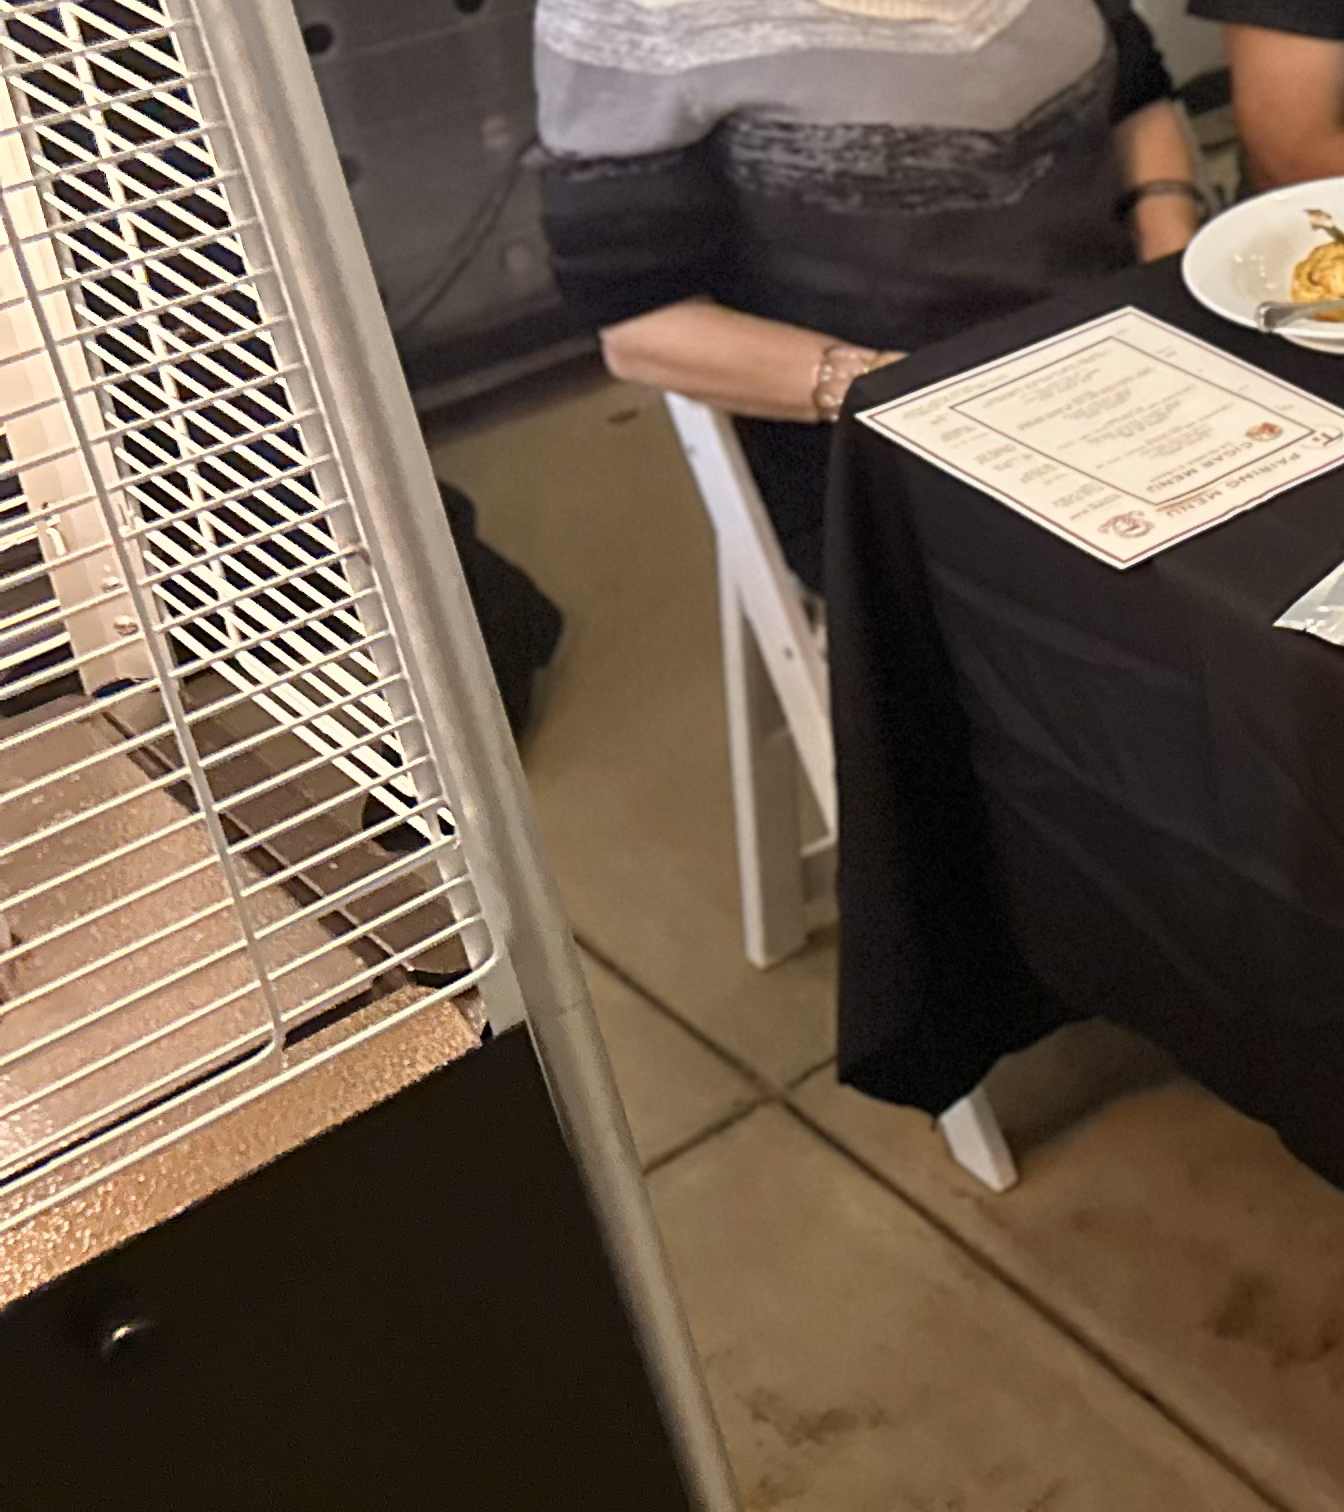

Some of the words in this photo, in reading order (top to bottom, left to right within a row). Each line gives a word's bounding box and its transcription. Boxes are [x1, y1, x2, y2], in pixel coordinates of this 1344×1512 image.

[1146, 467, 1198, 493] MENU
[1225, 451, 1301, 489] PAIRING
[1165, 489, 1223, 518] MENU
